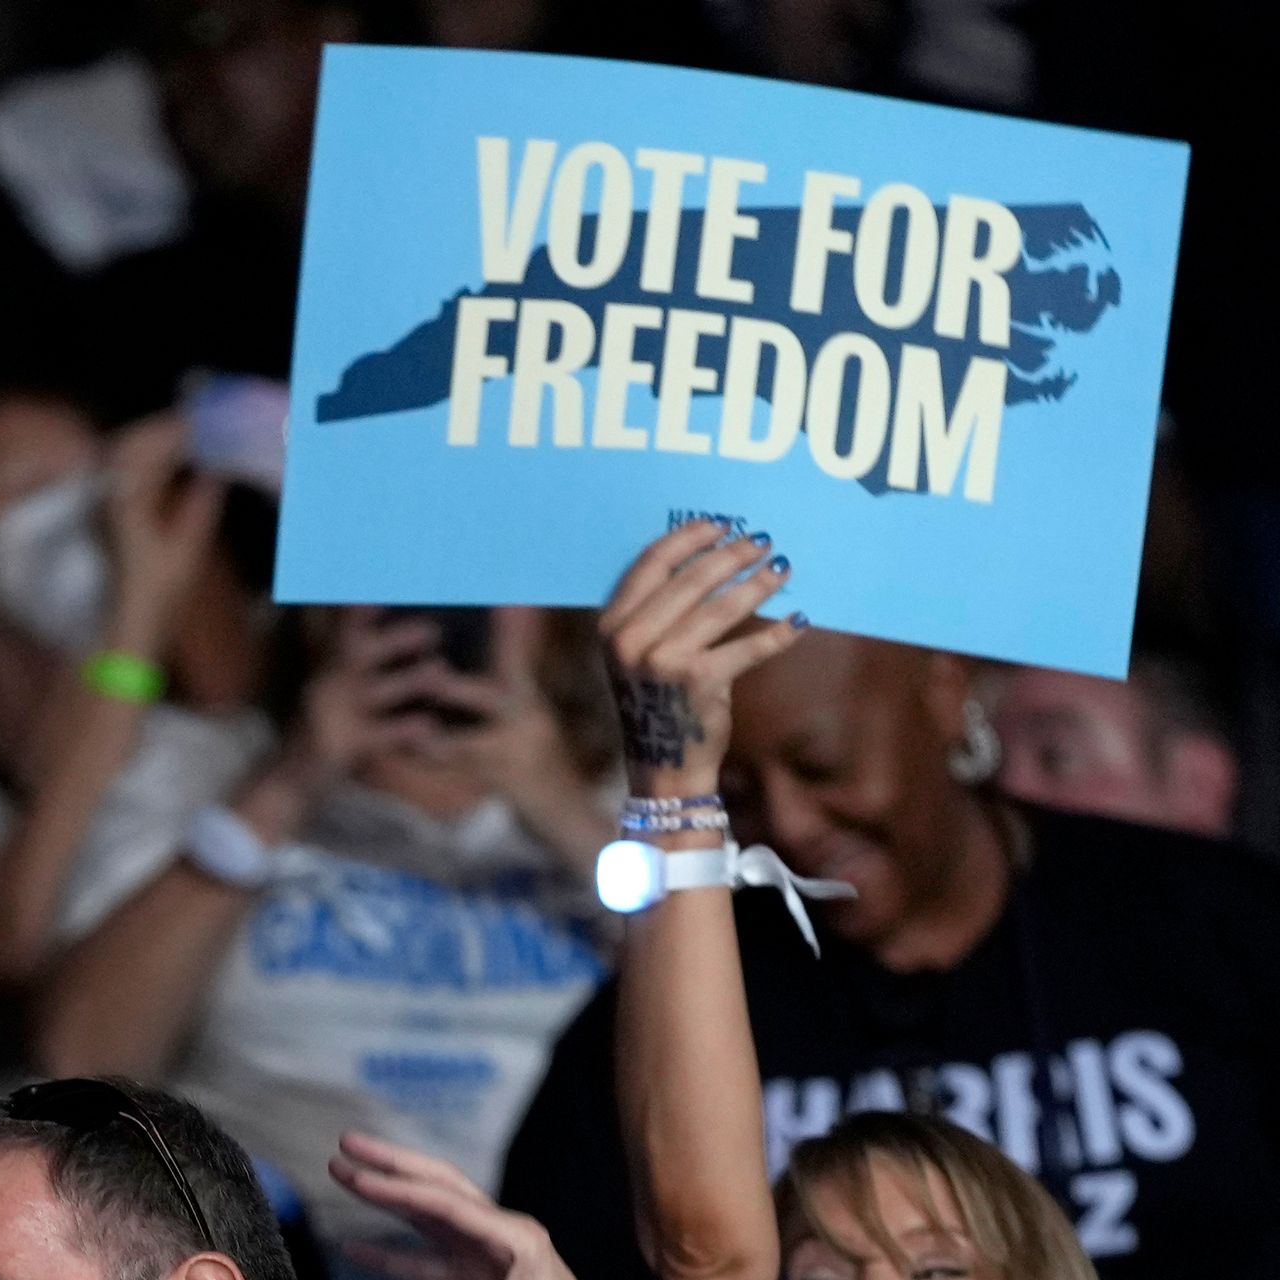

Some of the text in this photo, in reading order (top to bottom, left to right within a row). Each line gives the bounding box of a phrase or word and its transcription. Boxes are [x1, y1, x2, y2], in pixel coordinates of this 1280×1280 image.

[476, 136, 1025, 349] VOTE FOR
[446, 296, 1010, 505] FREEDOM
